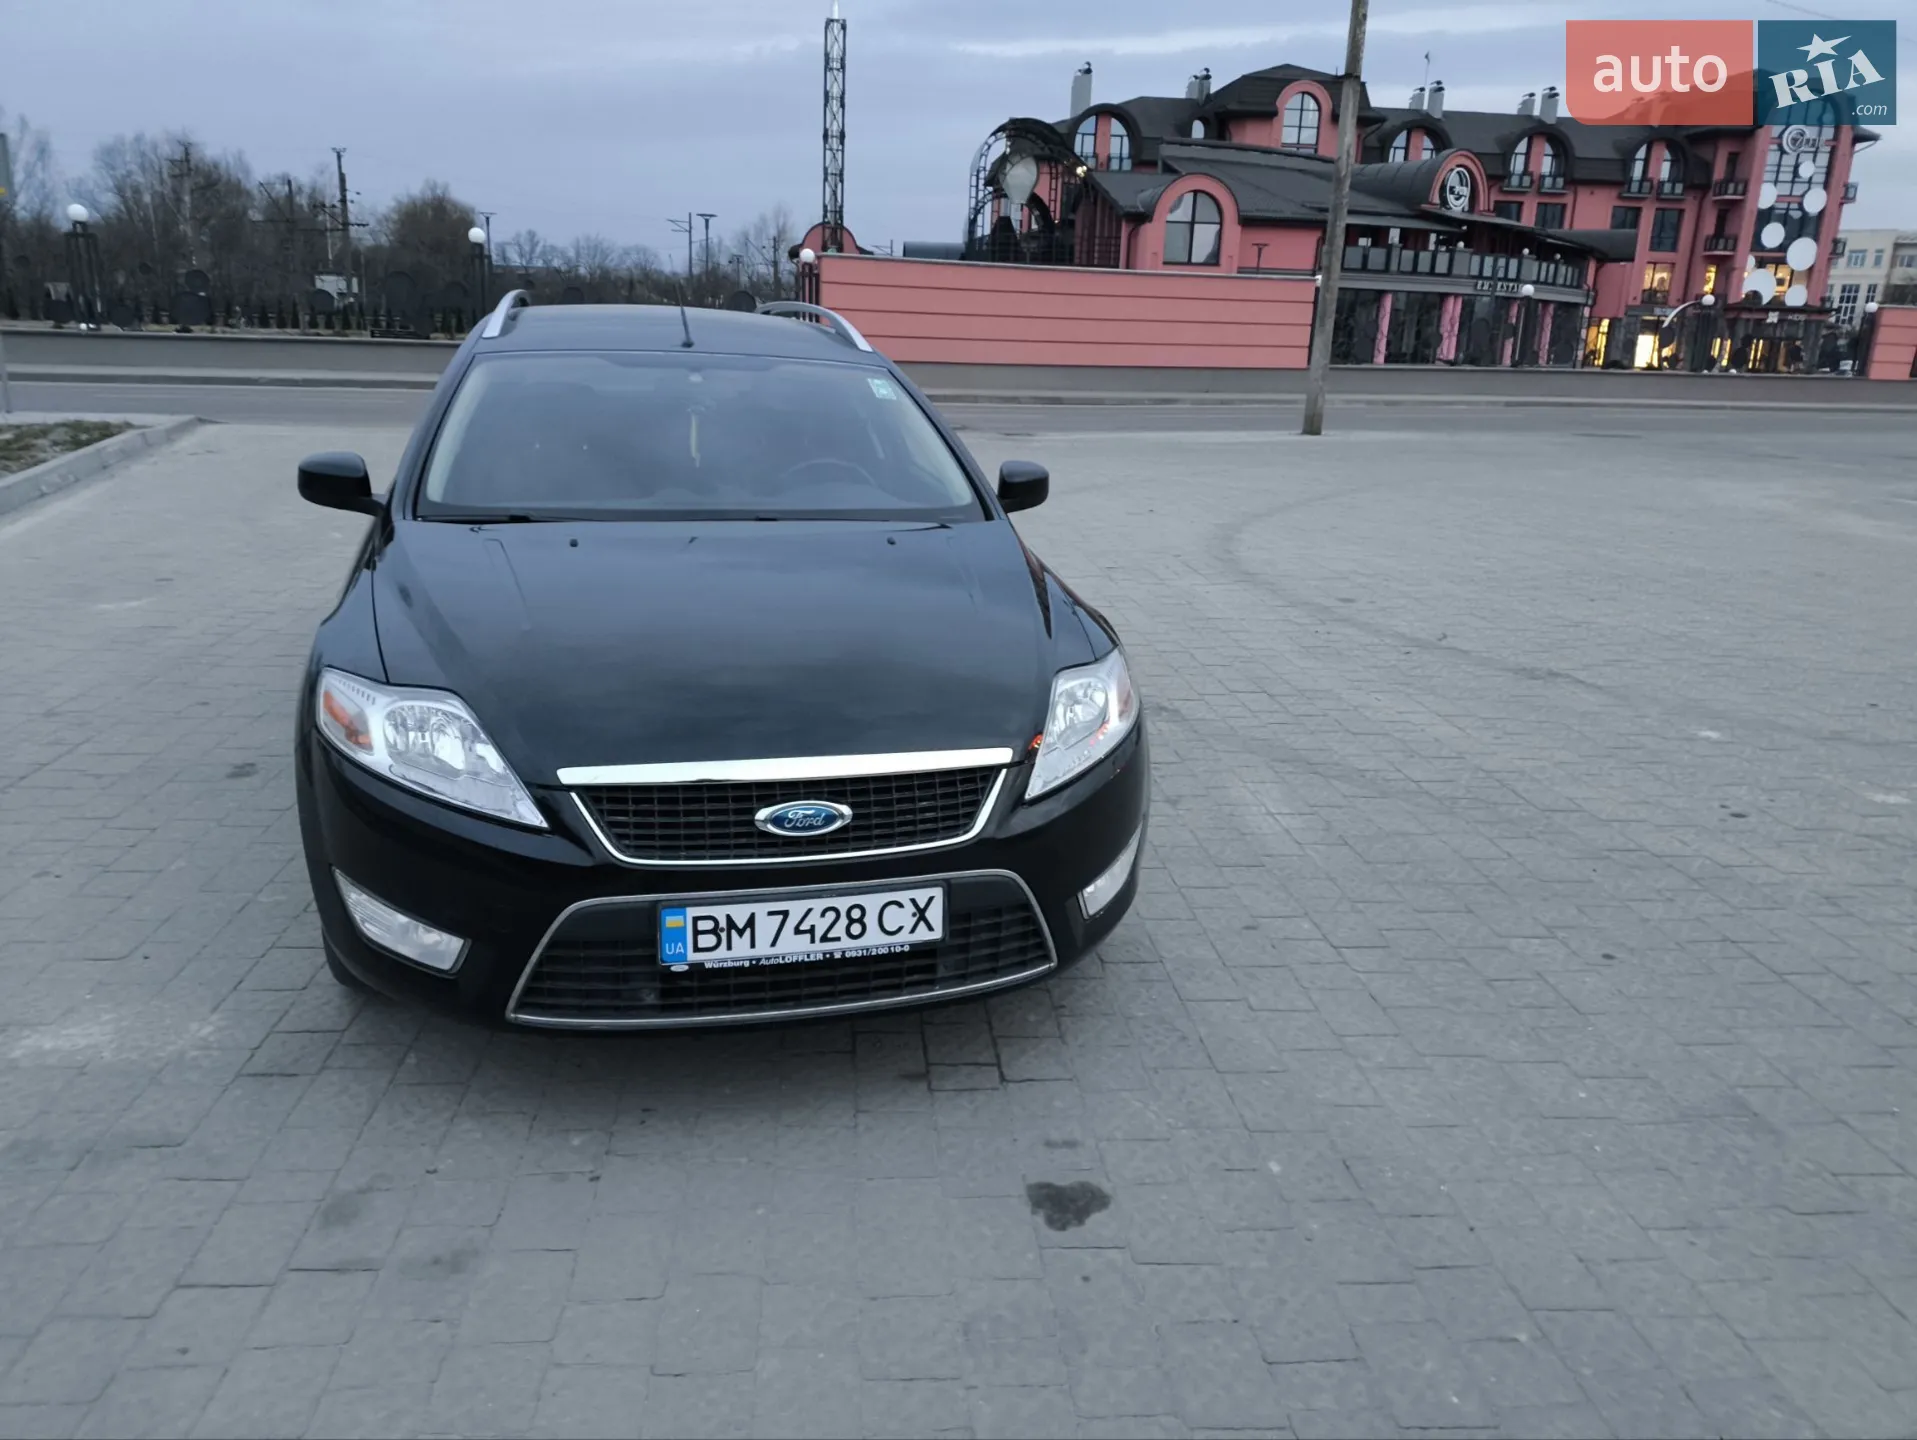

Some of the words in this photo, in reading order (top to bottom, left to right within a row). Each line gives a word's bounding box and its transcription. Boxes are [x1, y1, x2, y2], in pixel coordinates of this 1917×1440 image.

[784, 810, 826, 828] Ford
[692, 912, 756, 953] BM
[767, 904, 867, 948] 7428
[877, 896, 936, 936] CX
[665, 942, 685, 955] UA
